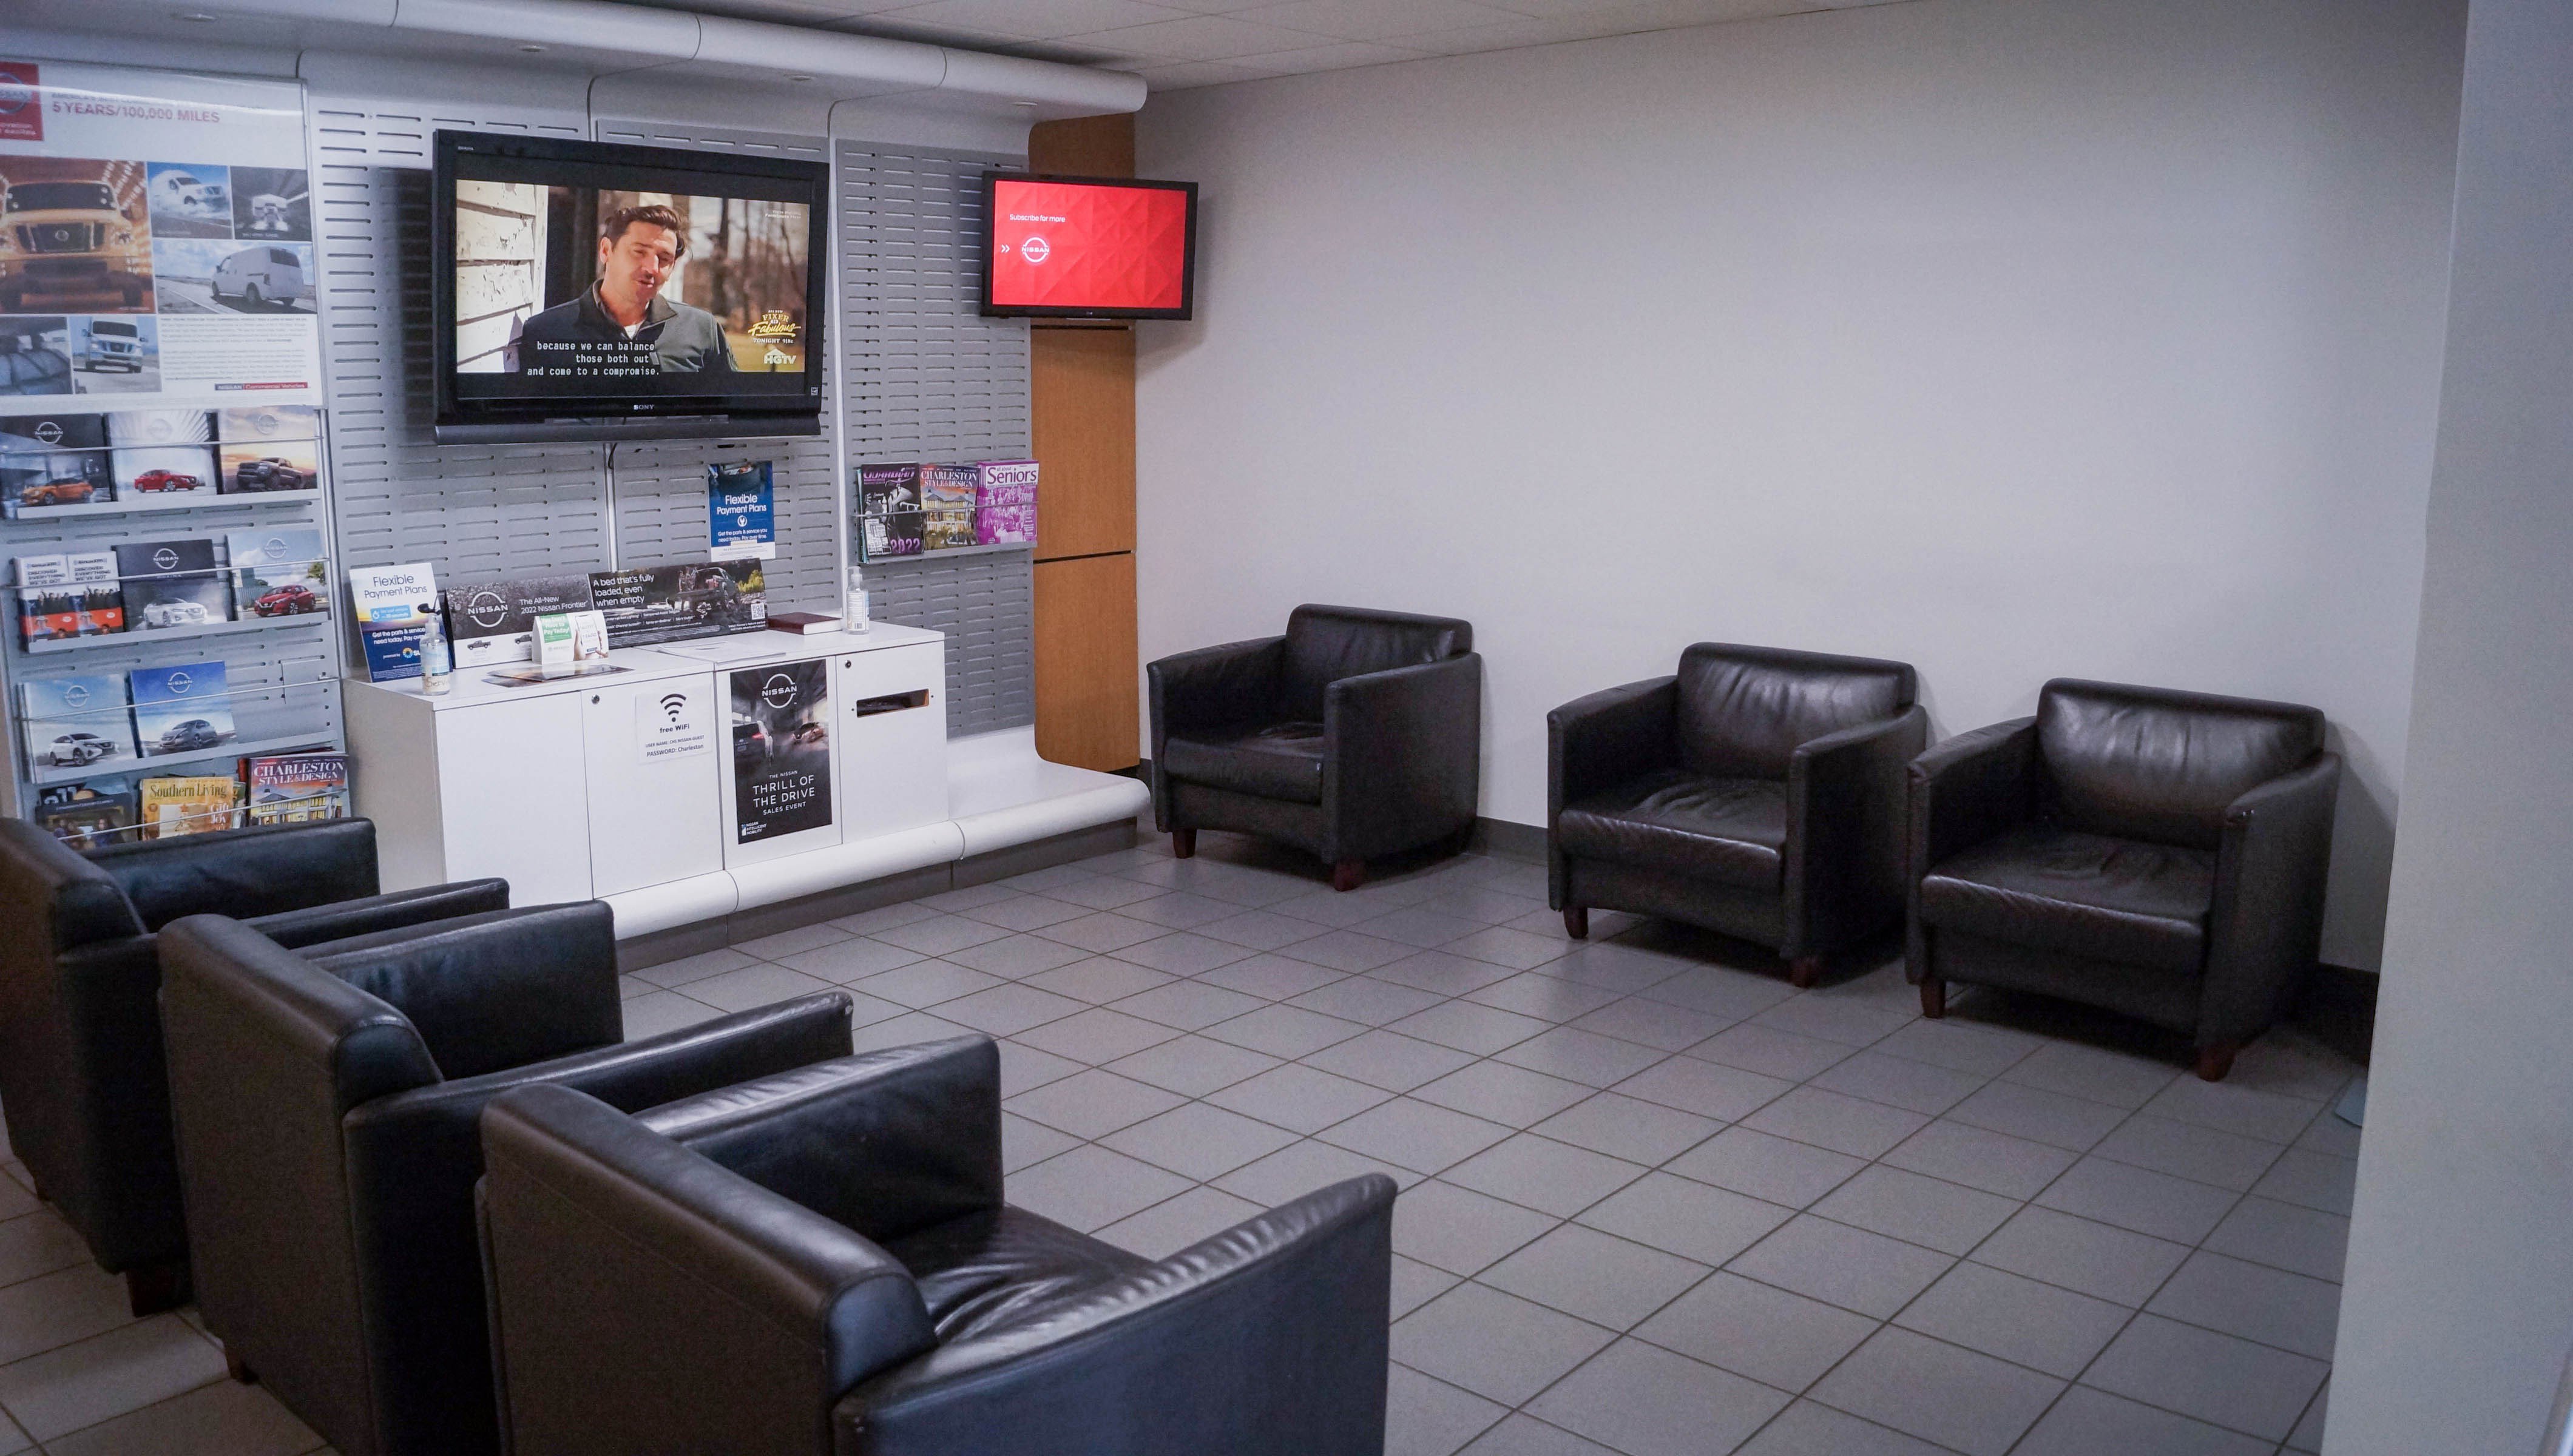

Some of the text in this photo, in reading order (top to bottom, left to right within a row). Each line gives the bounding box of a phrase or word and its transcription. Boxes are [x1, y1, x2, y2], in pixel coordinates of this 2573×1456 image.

[53, 101, 61, 113] 5
[178, 109, 220, 123] MILES
[762, 313, 789, 322] FIXER
[748, 321, 801, 336] Fabulous
[537, 341, 575, 350] because
[618, 342, 655, 351] balance
[576, 354, 603, 363] those
[607, 354, 629, 363] both
[764, 355, 797, 364] HGTV
[527, 366, 544, 376] and
[603, 366, 660, 377] compromise.
[921, 471, 978, 481] CHARLESTON
[987, 467, 1037, 485] Seniors
[725, 493, 758, 505] Flexible
[717, 505, 748, 516] Payment
[373, 575, 414, 587] Flexible
[600, 578, 616, 587] bed
[617, 576, 638, 585] that's
[639, 574, 655, 583] fully
[364, 585, 428, 599] Payment Plans
[595, 587, 624, 597] loaded,
[597, 596, 645, 607] when empty
[467, 604, 509, 615] NISSAN
[521, 606, 537, 615] 2022
[762, 686, 797, 697] NISSAN
[647, 744, 704, 757] PASSWORD: Charleston
[253, 761, 345, 777] CHARLESTON
[150, 784, 228, 798] Southern Living
[752, 775, 814, 795] THRILL OF
[753, 787, 815, 807] THE DRIVE
[763, 801, 806, 815] SALES EVENT
